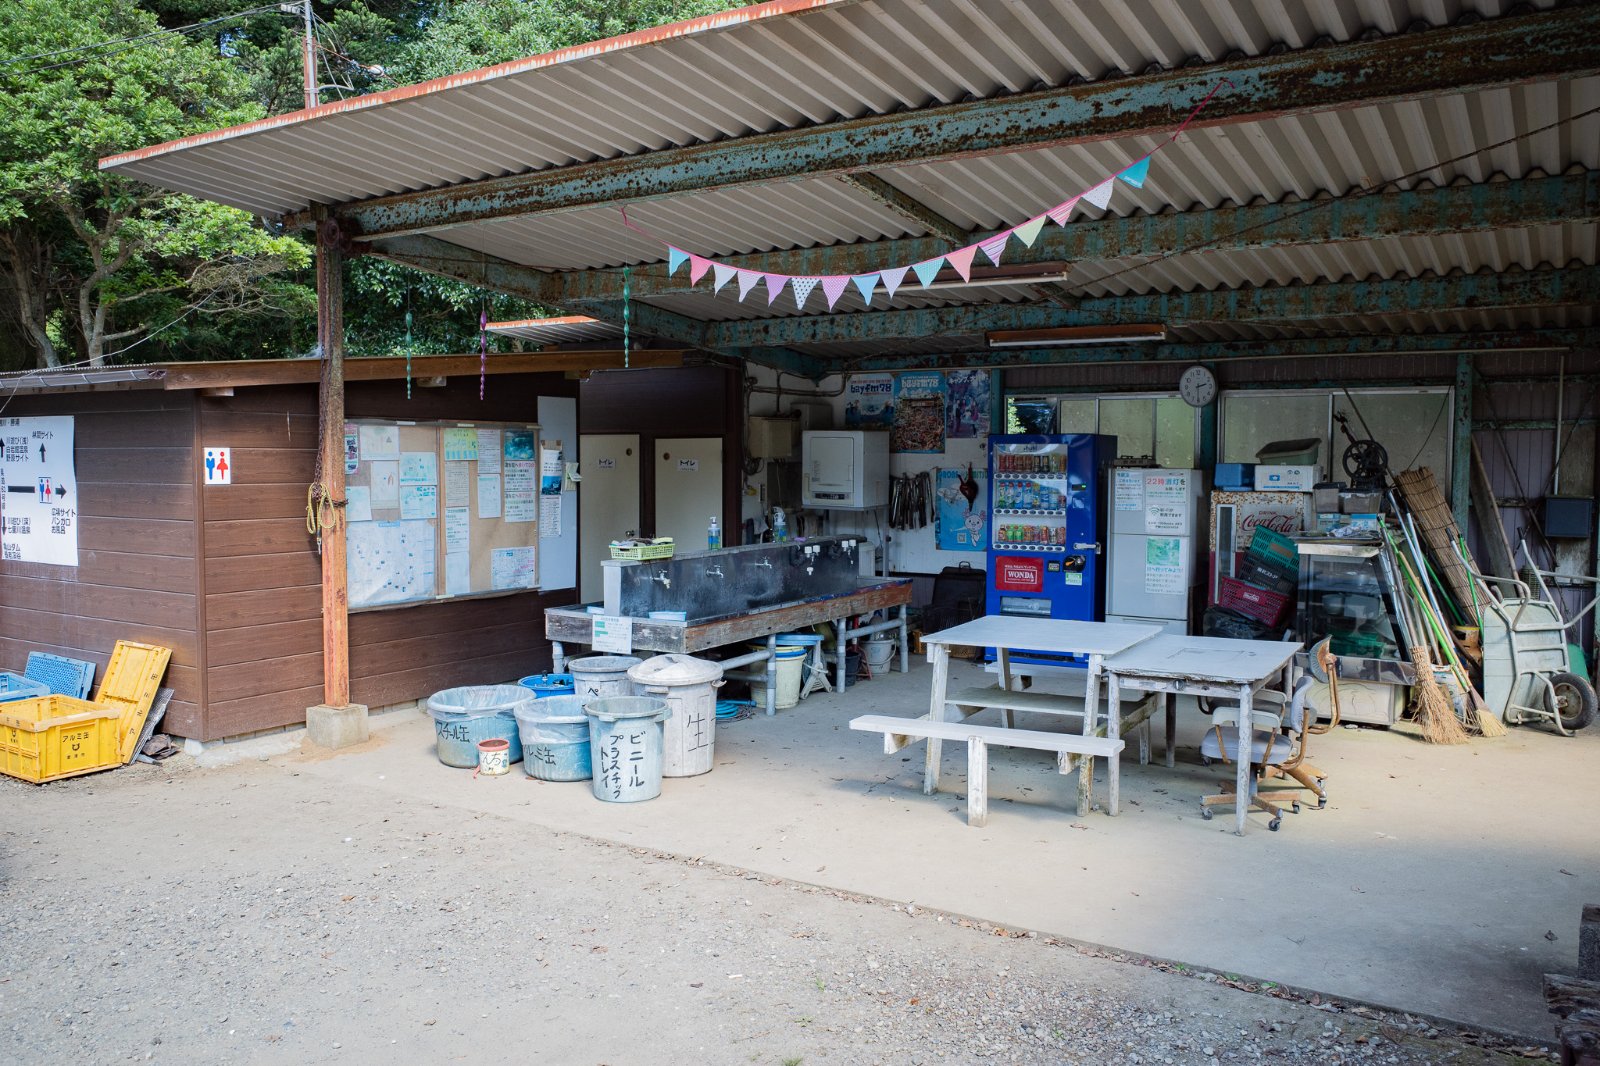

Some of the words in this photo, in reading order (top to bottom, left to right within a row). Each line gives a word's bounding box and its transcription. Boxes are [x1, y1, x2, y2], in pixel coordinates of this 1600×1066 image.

[850, 383, 892, 395] bayfm78
[436, 720, 470, 743] スチール缶
[600, 746, 609, 788] トレイ
[610, 734, 624, 799] プラスチック
[629, 730, 646, 787] ビニール
